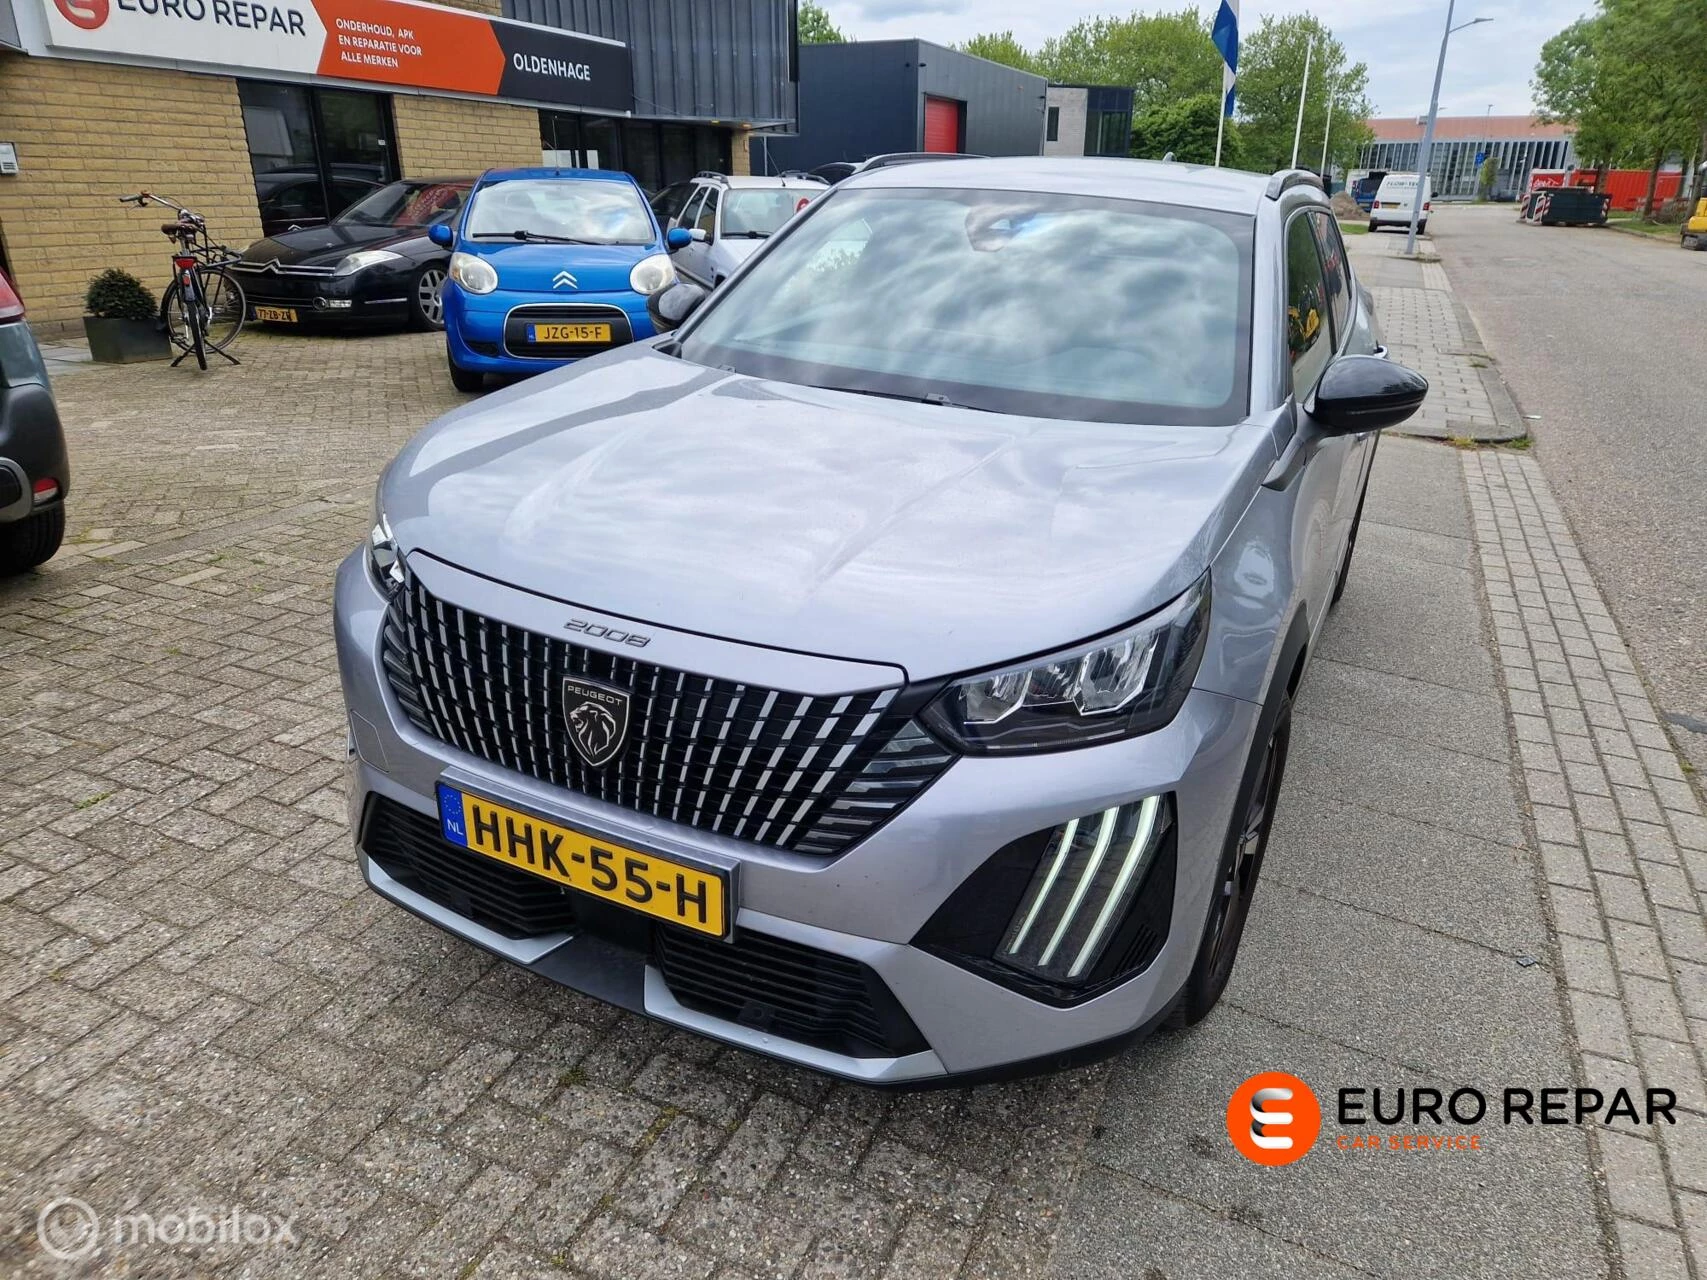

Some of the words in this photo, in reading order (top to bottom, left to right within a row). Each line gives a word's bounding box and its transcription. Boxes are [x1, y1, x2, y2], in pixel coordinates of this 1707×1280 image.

[213, 1, 306, 36] REPAR
[336, 18, 395, 38] ONDERHOUD,
[398, 28, 414, 40] APK
[338, 35, 351, 46] EN
[352, 36, 398, 52] REPARATIE
[398, 43, 422, 56] VOOR
[341, 51, 362, 63] ALLE
[363, 54, 399, 68] MERKEN
[513, 52, 591, 81] OLDENHAGE
[544, 326, 602, 340] JZG-15-F
[563, 618, 651, 648] 2008
[567, 685, 623, 705] PEUGEOT
[446, 818, 464, 836] NL
[472, 804, 707, 924] HHK-55-H
